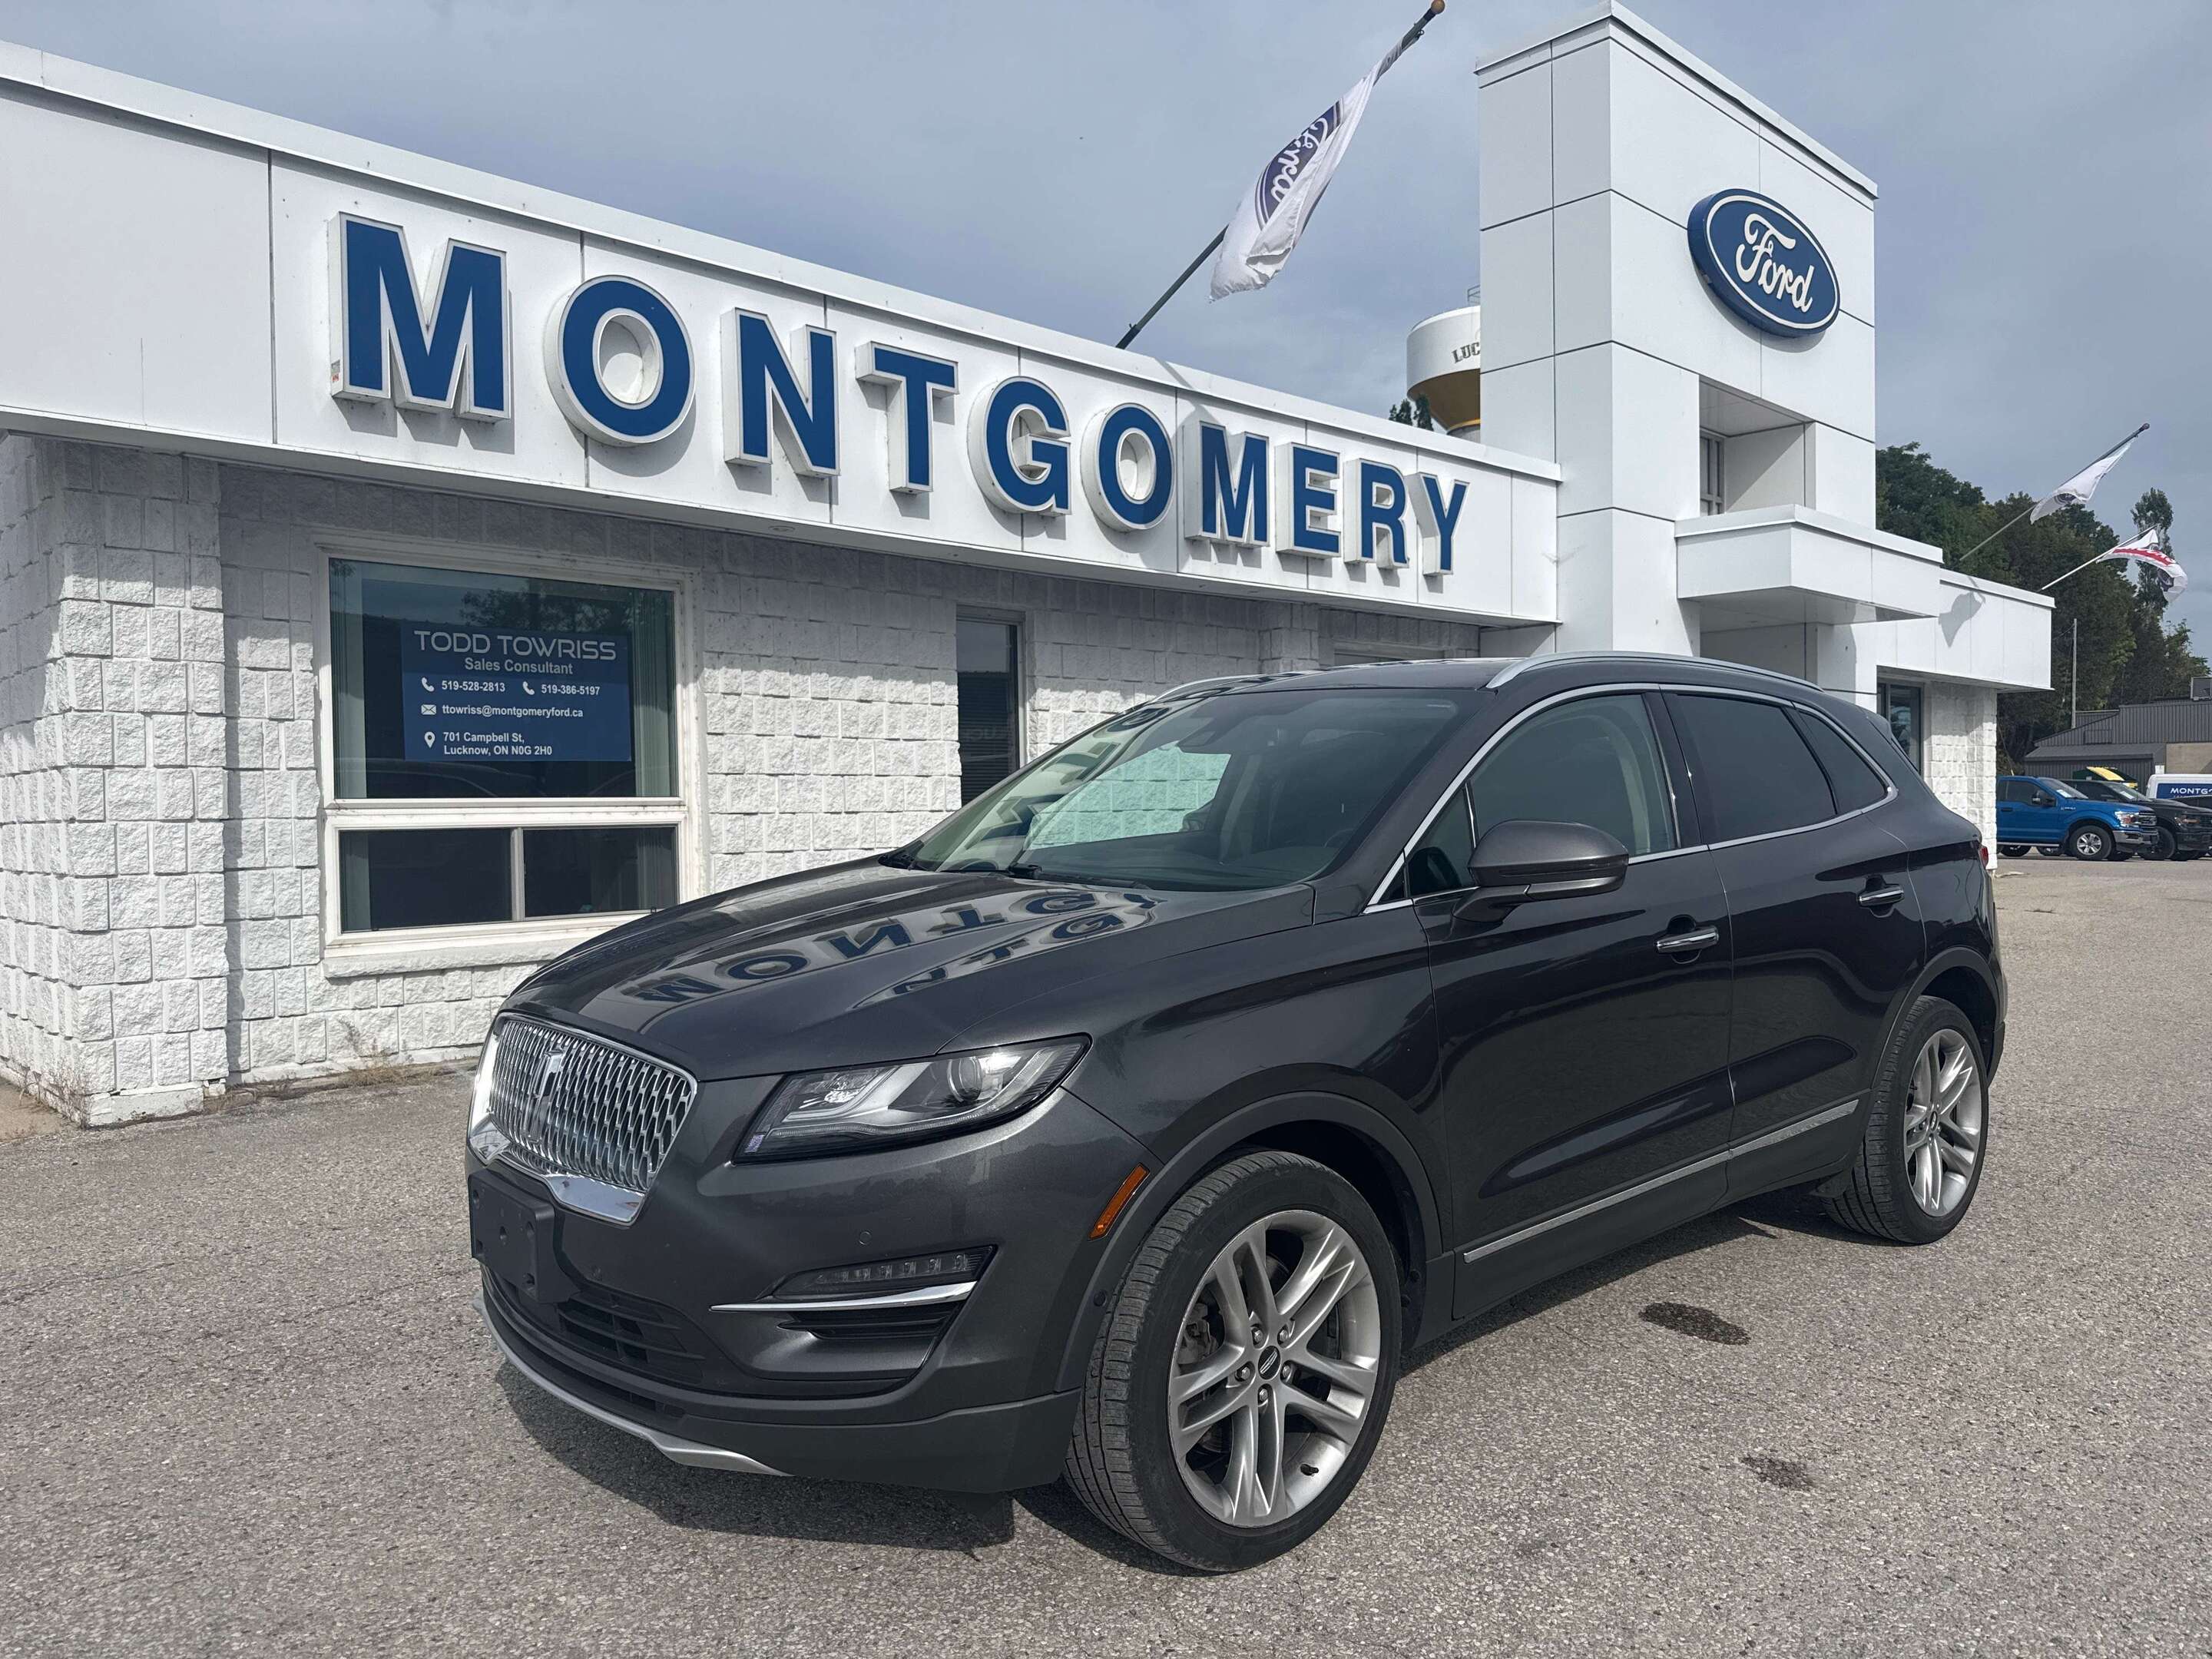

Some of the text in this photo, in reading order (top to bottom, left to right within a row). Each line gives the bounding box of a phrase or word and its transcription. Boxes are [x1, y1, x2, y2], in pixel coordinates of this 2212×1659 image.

[1736, 213, 1815, 313] Ford
[333, 212, 1470, 577] MONTGOMERY
[414, 630, 617, 661] TODD TOWRISS
[464, 657, 573, 674] Sales Consultant
[441, 680, 505, 692] 519-528-2813
[541, 684, 601, 695] 519-386-5197
[442, 704, 584, 718] ttowriss@montgomeryford.ca
[443, 732, 525, 743] 701 Campbell St,
[444, 745, 492, 757] Lucknow,
[493, 746, 509, 755] ON
